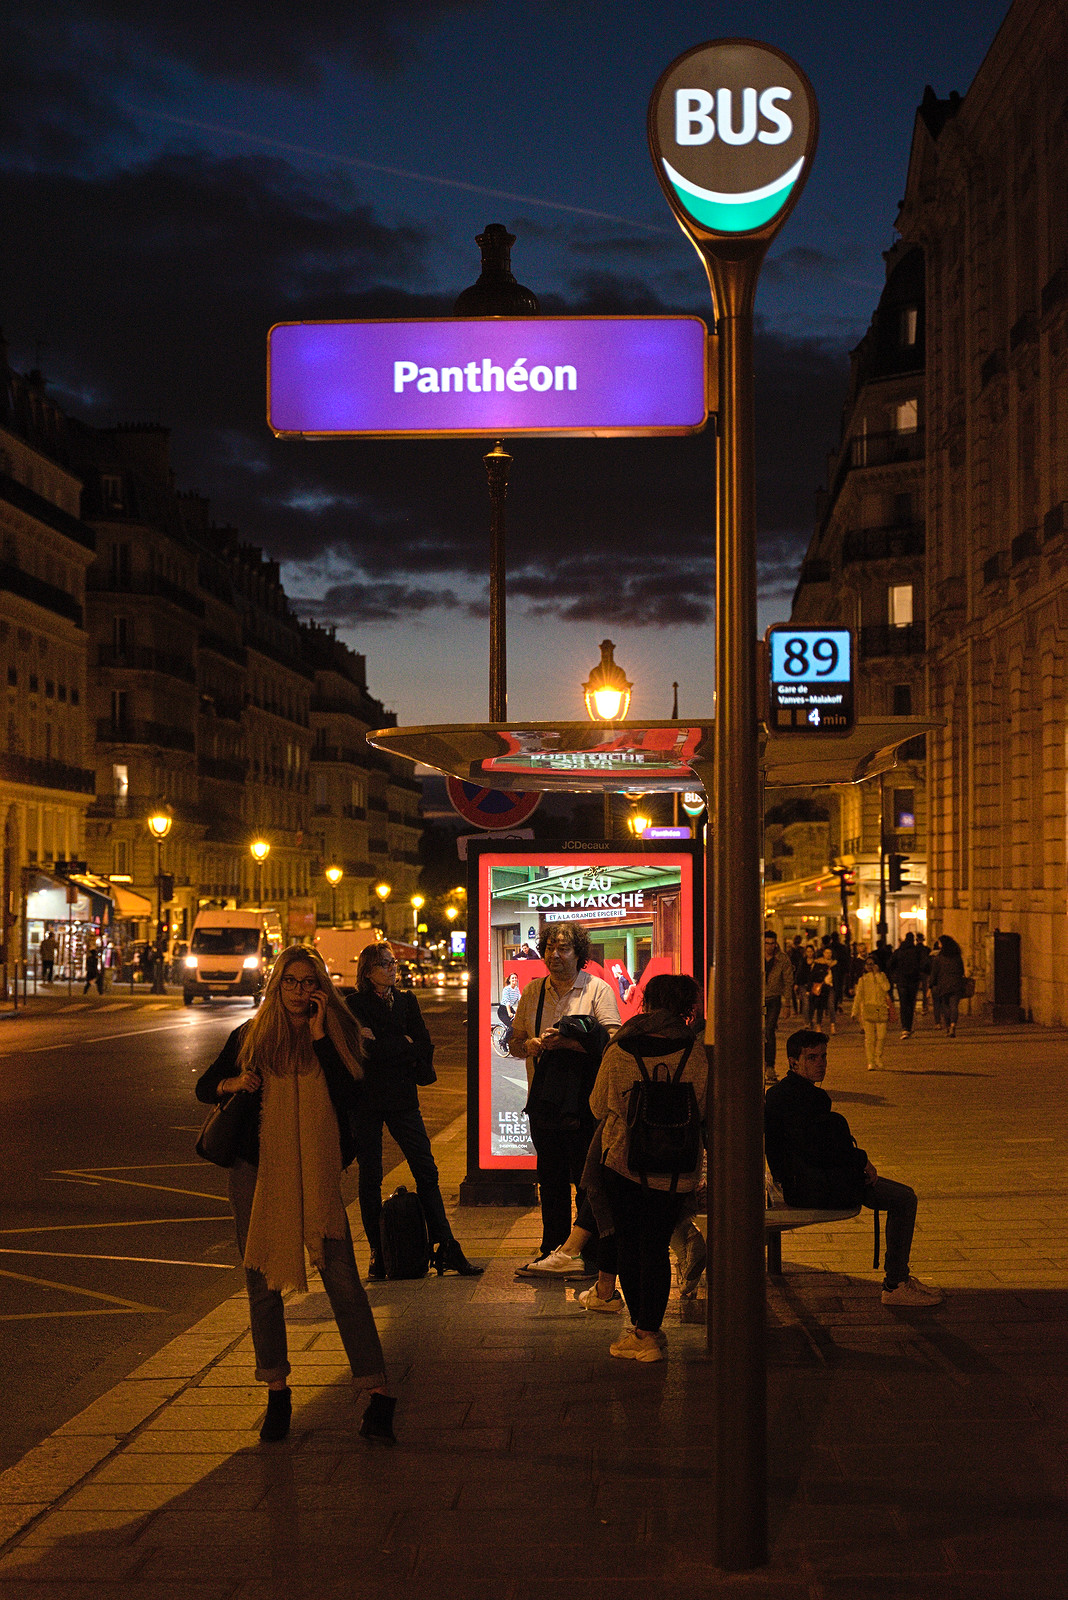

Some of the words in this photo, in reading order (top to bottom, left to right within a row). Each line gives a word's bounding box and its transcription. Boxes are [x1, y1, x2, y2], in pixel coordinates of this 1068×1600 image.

[676, 86, 793, 146] BUS
[394, 357, 577, 393] Panthéon
[783, 637, 839, 677] 89
[777, 684, 796, 694] Gare
[797, 684, 808, 694] de
[808, 707, 820, 726] 4
[823, 714, 847, 725] min
[562, 841, 609, 850] JCDecaux
[559, 877, 583, 892] VU
[588, 877, 612, 892] AU
[528, 893, 567, 908] BON
[570, 890, 644, 908] MARCHÉ
[571, 911, 597, 919] GRANDE
[498, 1111, 519, 1122] LES
[521, 1111, 529, 1122] J
[498, 1121, 527, 1134] TRÈS
